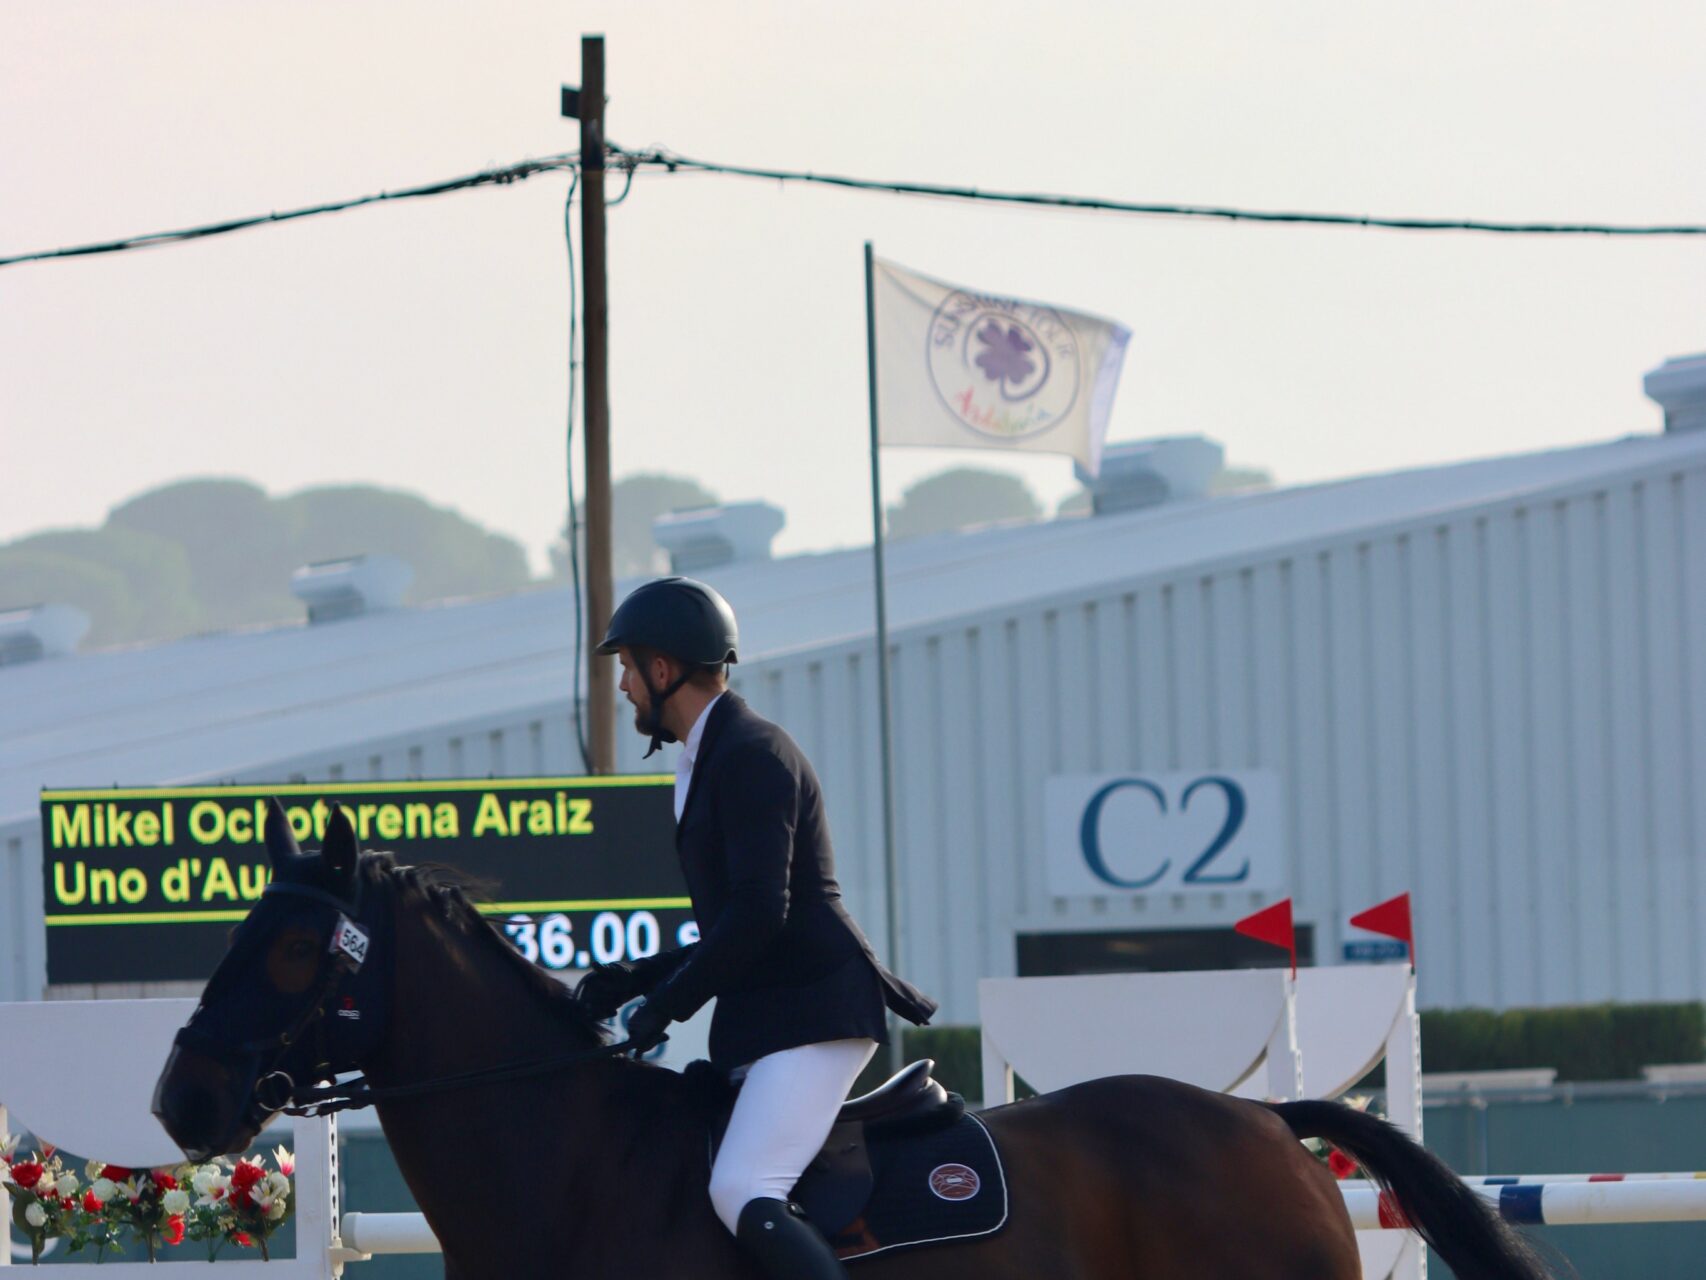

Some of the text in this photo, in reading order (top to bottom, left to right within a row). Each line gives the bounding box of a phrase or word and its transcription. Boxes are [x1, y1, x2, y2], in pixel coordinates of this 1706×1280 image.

[51, 802, 174, 848] Mikel
[473, 791, 594, 837] Araiz
[1079, 775, 1250, 890] C2
[54, 857, 274, 905] Uno d'Au
[341, 928, 367, 959] 564
